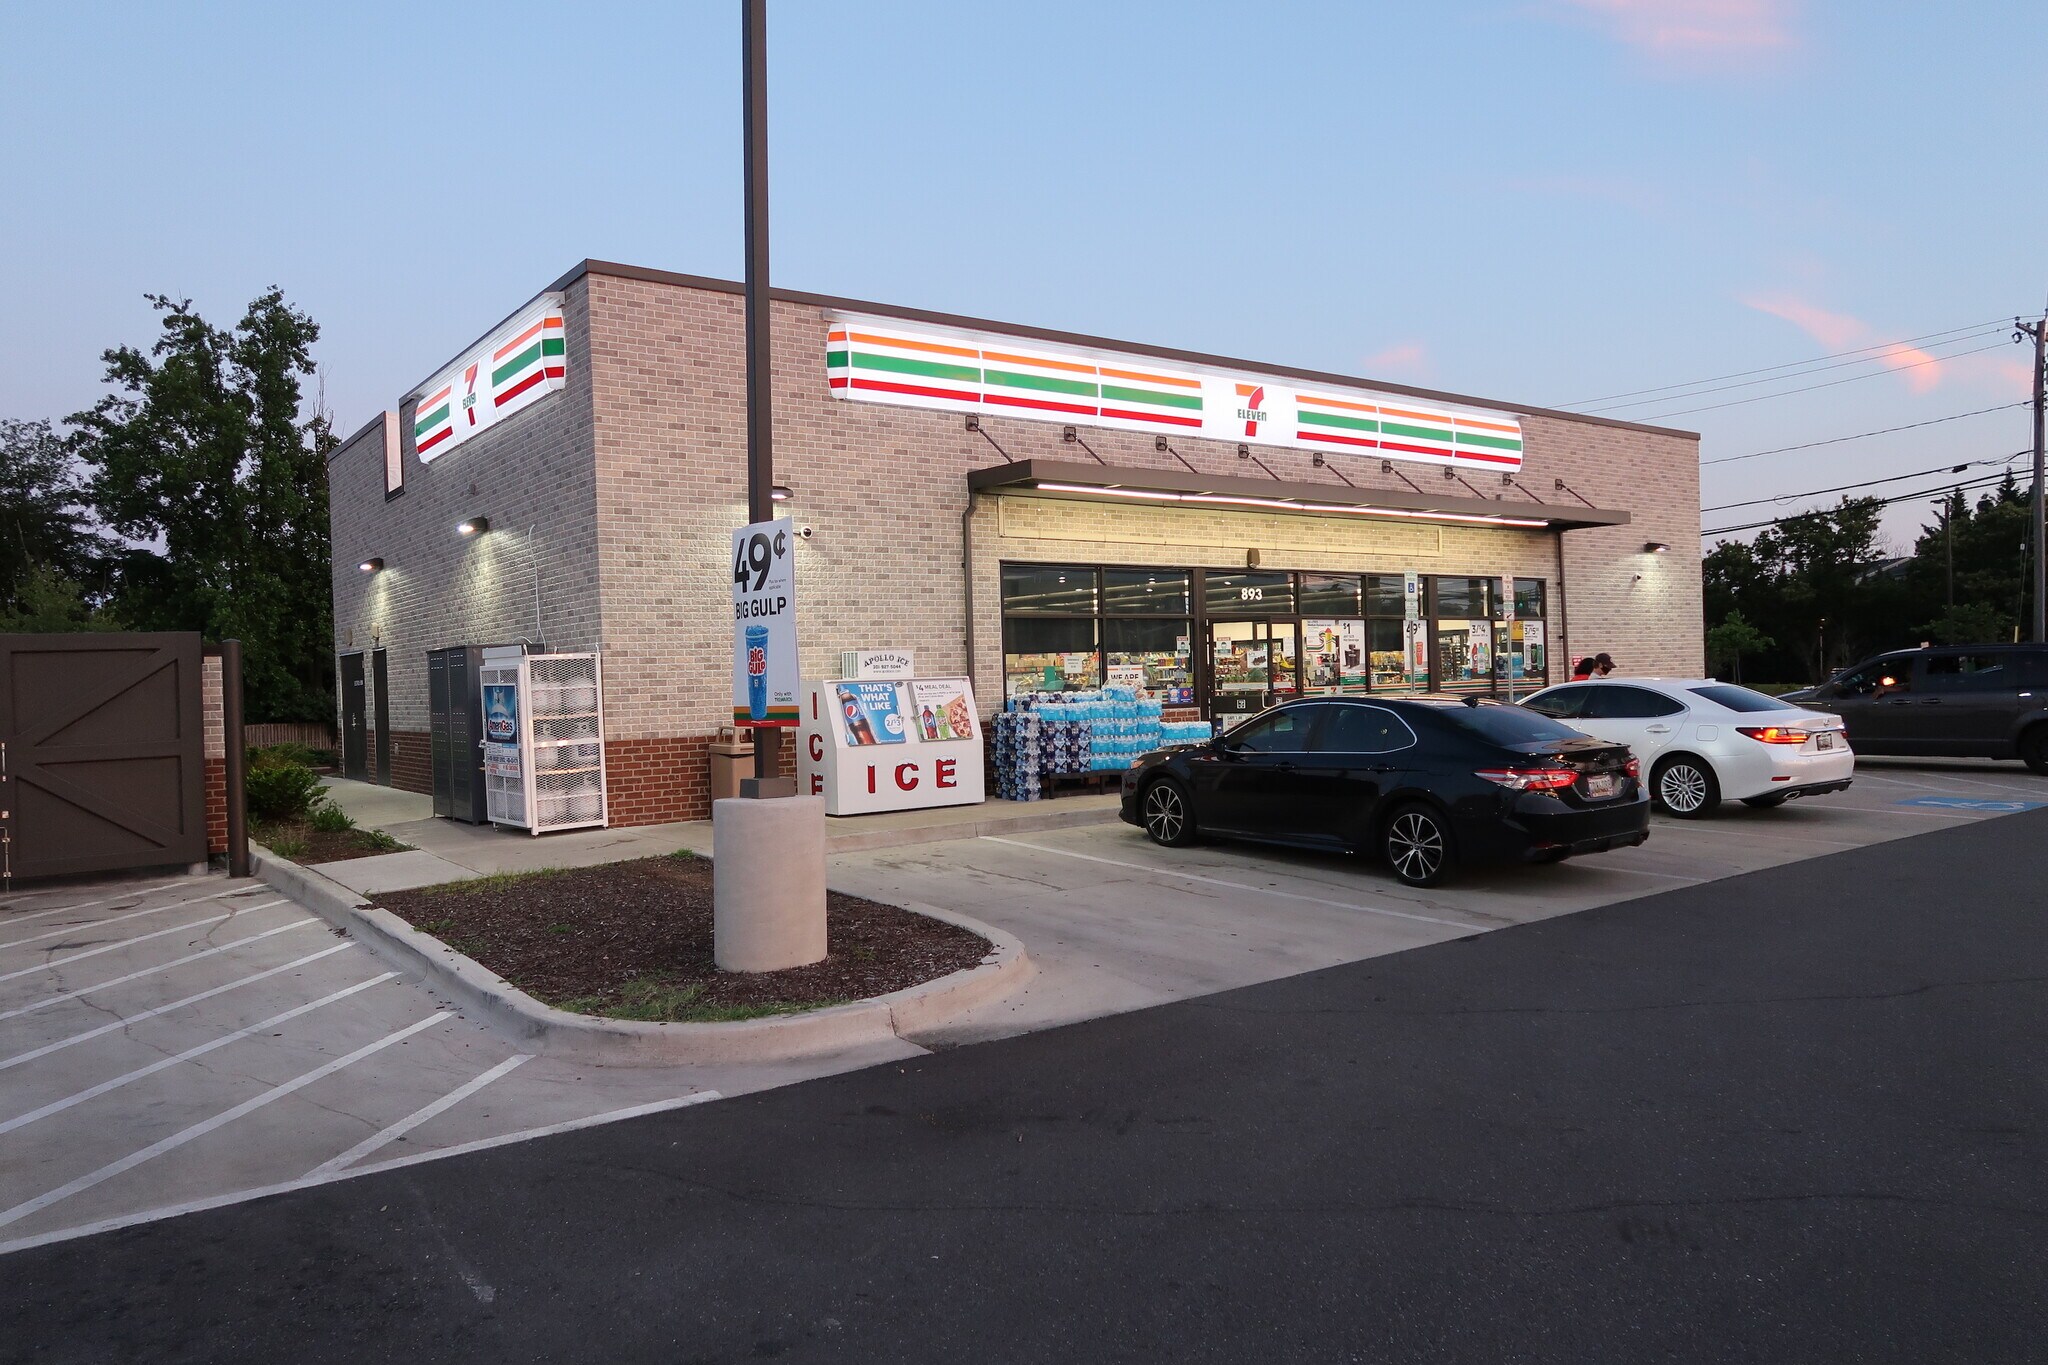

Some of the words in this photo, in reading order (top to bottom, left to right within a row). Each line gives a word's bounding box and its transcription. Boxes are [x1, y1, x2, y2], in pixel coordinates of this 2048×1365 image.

[1235, 383, 1265, 437] 7
[734, 528, 787, 594] 49¢
[1241, 587, 1263, 601] 893
[736, 602, 749, 619] BIG
[751, 597, 787, 617] GULP
[863, 654, 895, 667] APOLLO
[897, 655, 910, 667] ICE
[748, 661, 766, 675] GULP
[858, 683, 893, 693] THAT'S
[860, 692, 890, 702] WHAT
[869, 702, 892, 711] LIKE
[488, 719, 513, 732] AmeriGas
[867, 755, 957, 794] ICE
